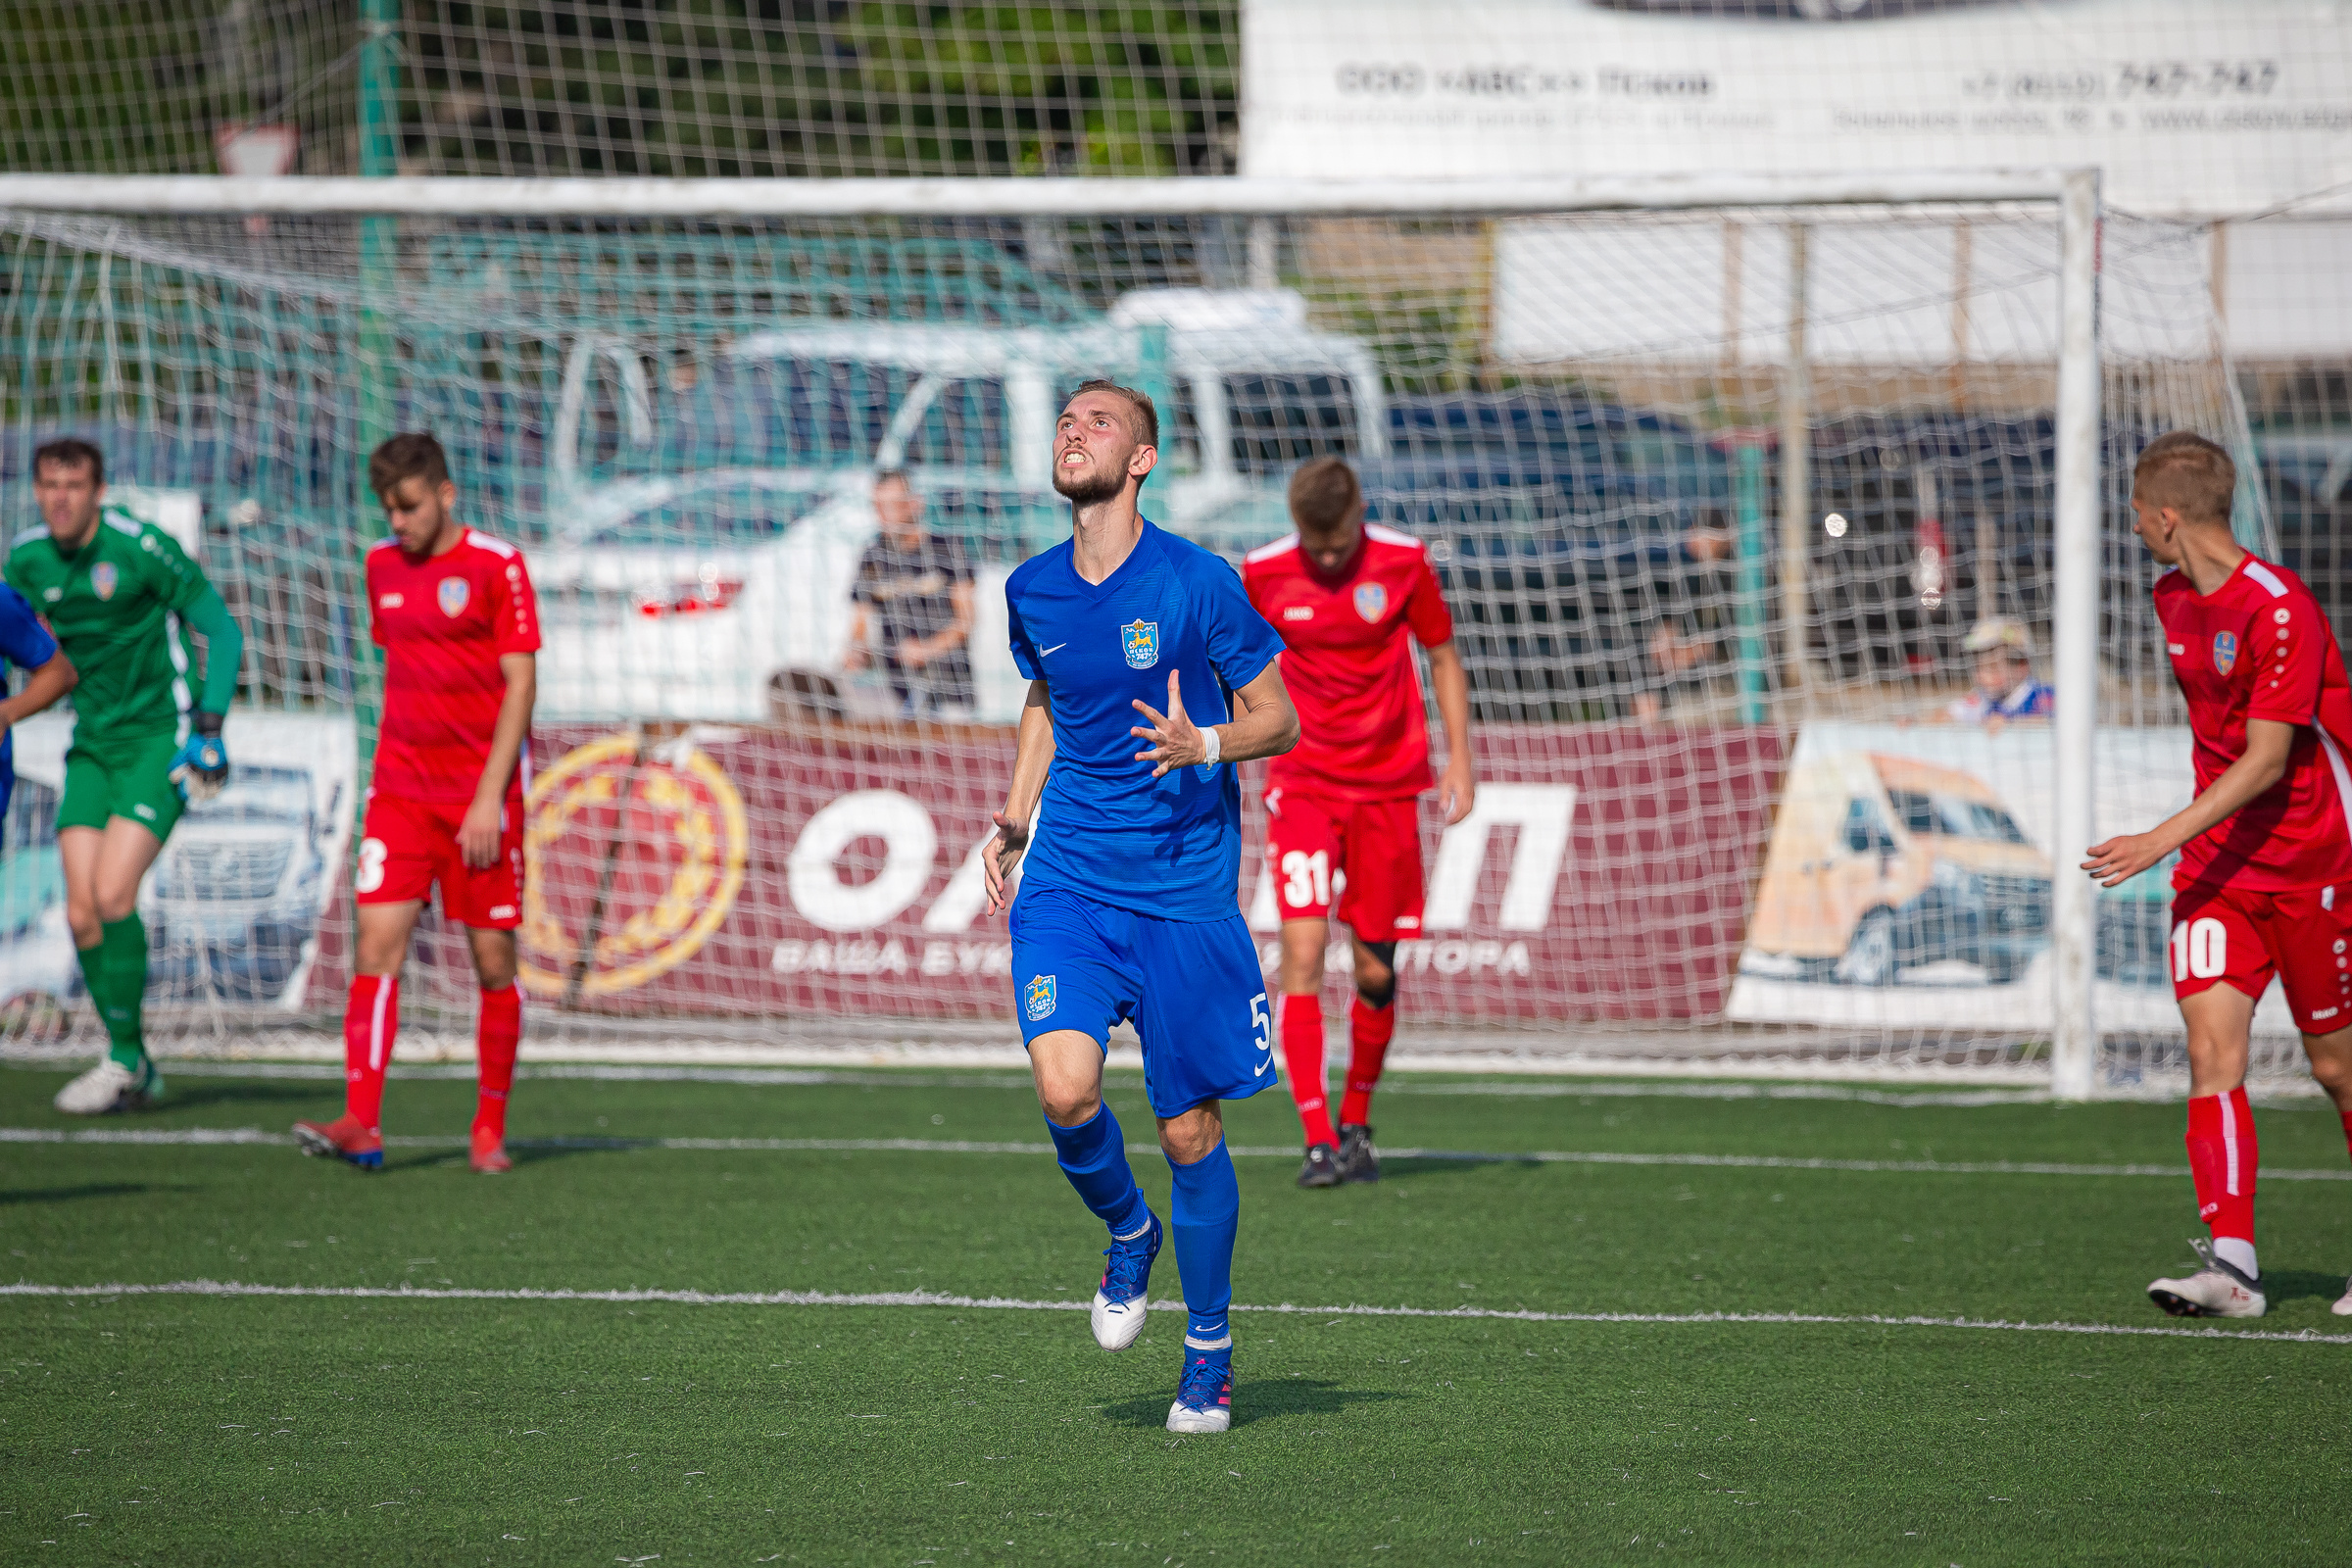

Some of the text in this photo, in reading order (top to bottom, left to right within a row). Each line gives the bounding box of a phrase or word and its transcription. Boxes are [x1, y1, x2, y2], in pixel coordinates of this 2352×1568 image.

[1282, 850, 1331, 908] 31
[2171, 917, 2227, 983] 10
[1250, 992, 1271, 1051] 5
